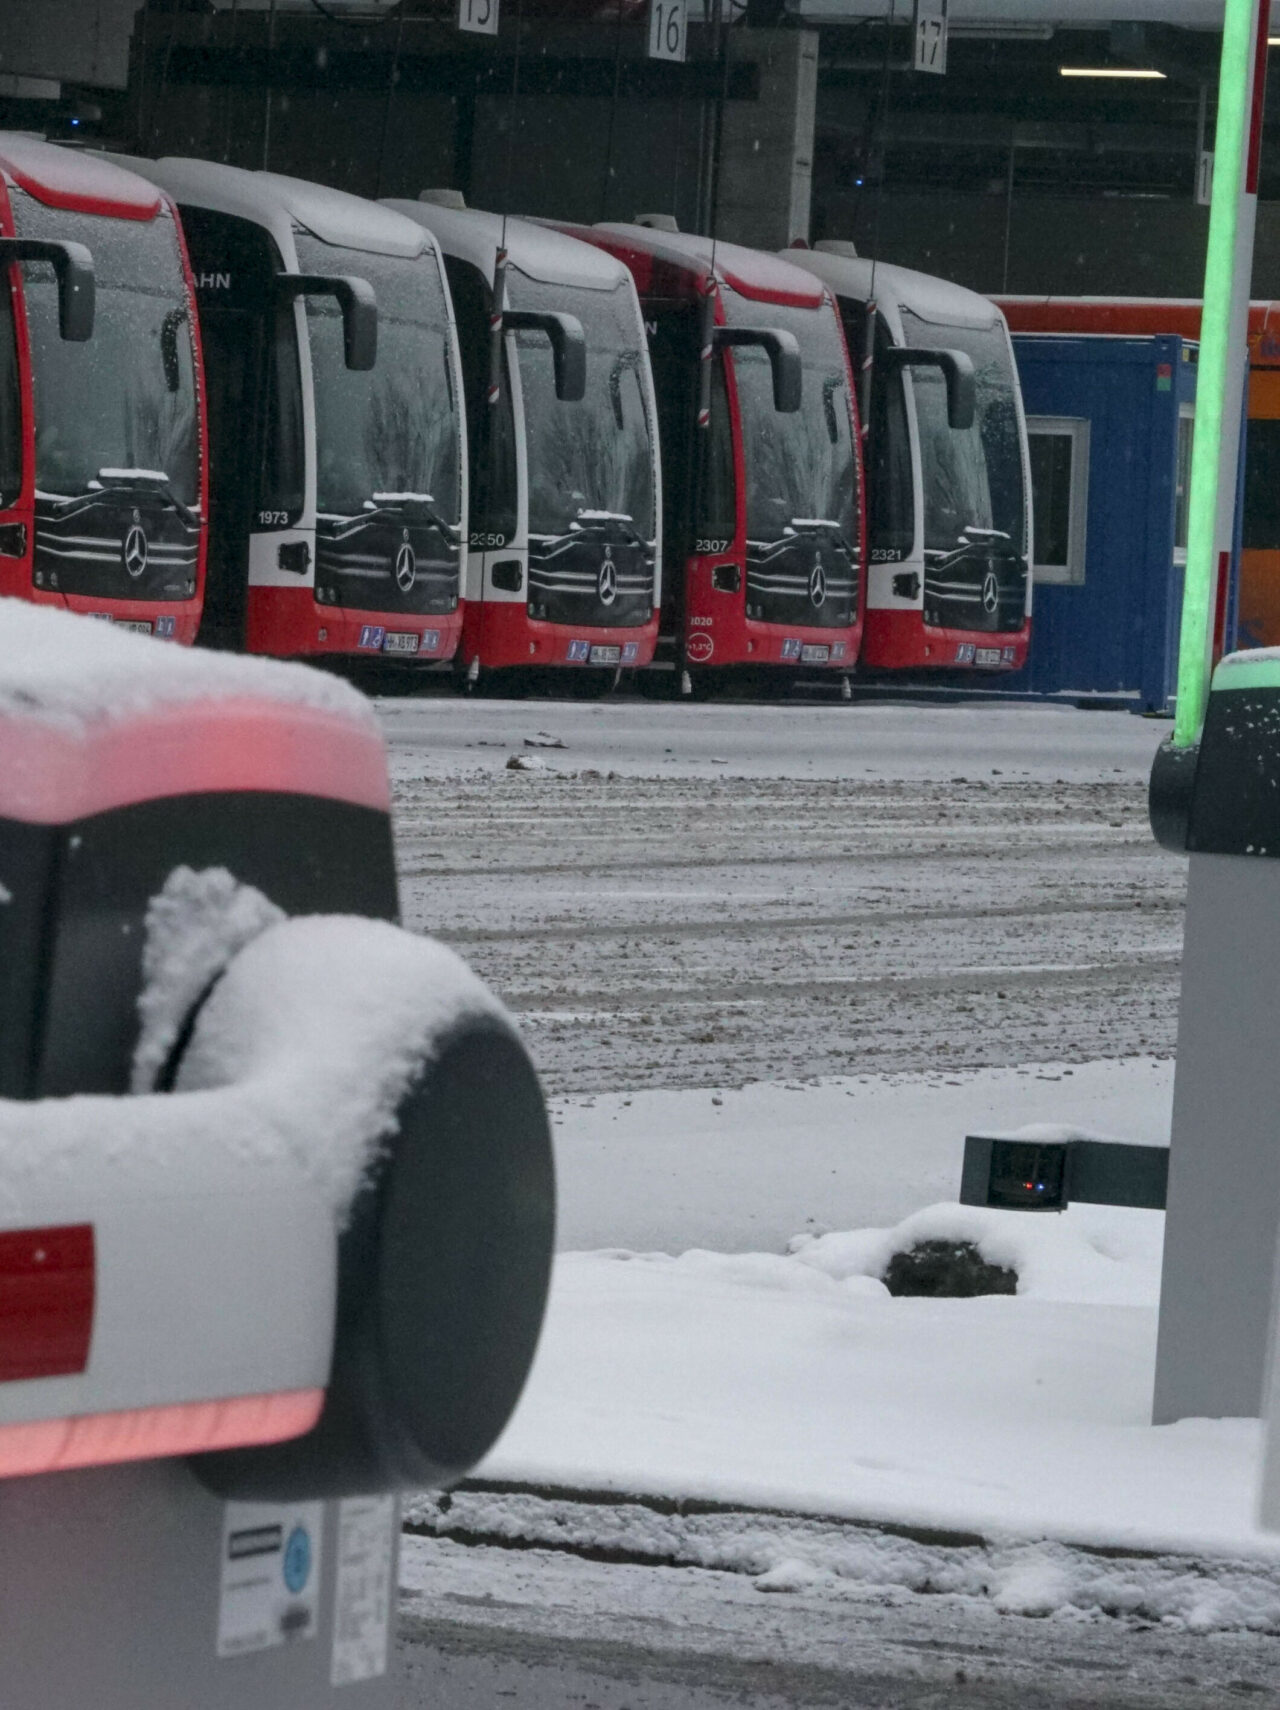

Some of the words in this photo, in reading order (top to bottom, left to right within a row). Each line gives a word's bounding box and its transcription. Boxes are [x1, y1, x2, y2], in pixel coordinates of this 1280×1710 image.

[655, 3, 680, 53] 16
[920, 20, 941, 65] 17
[259, 510, 289, 525] 1973
[696, 539, 729, 552] 2307
[871, 549, 902, 561] 2321
